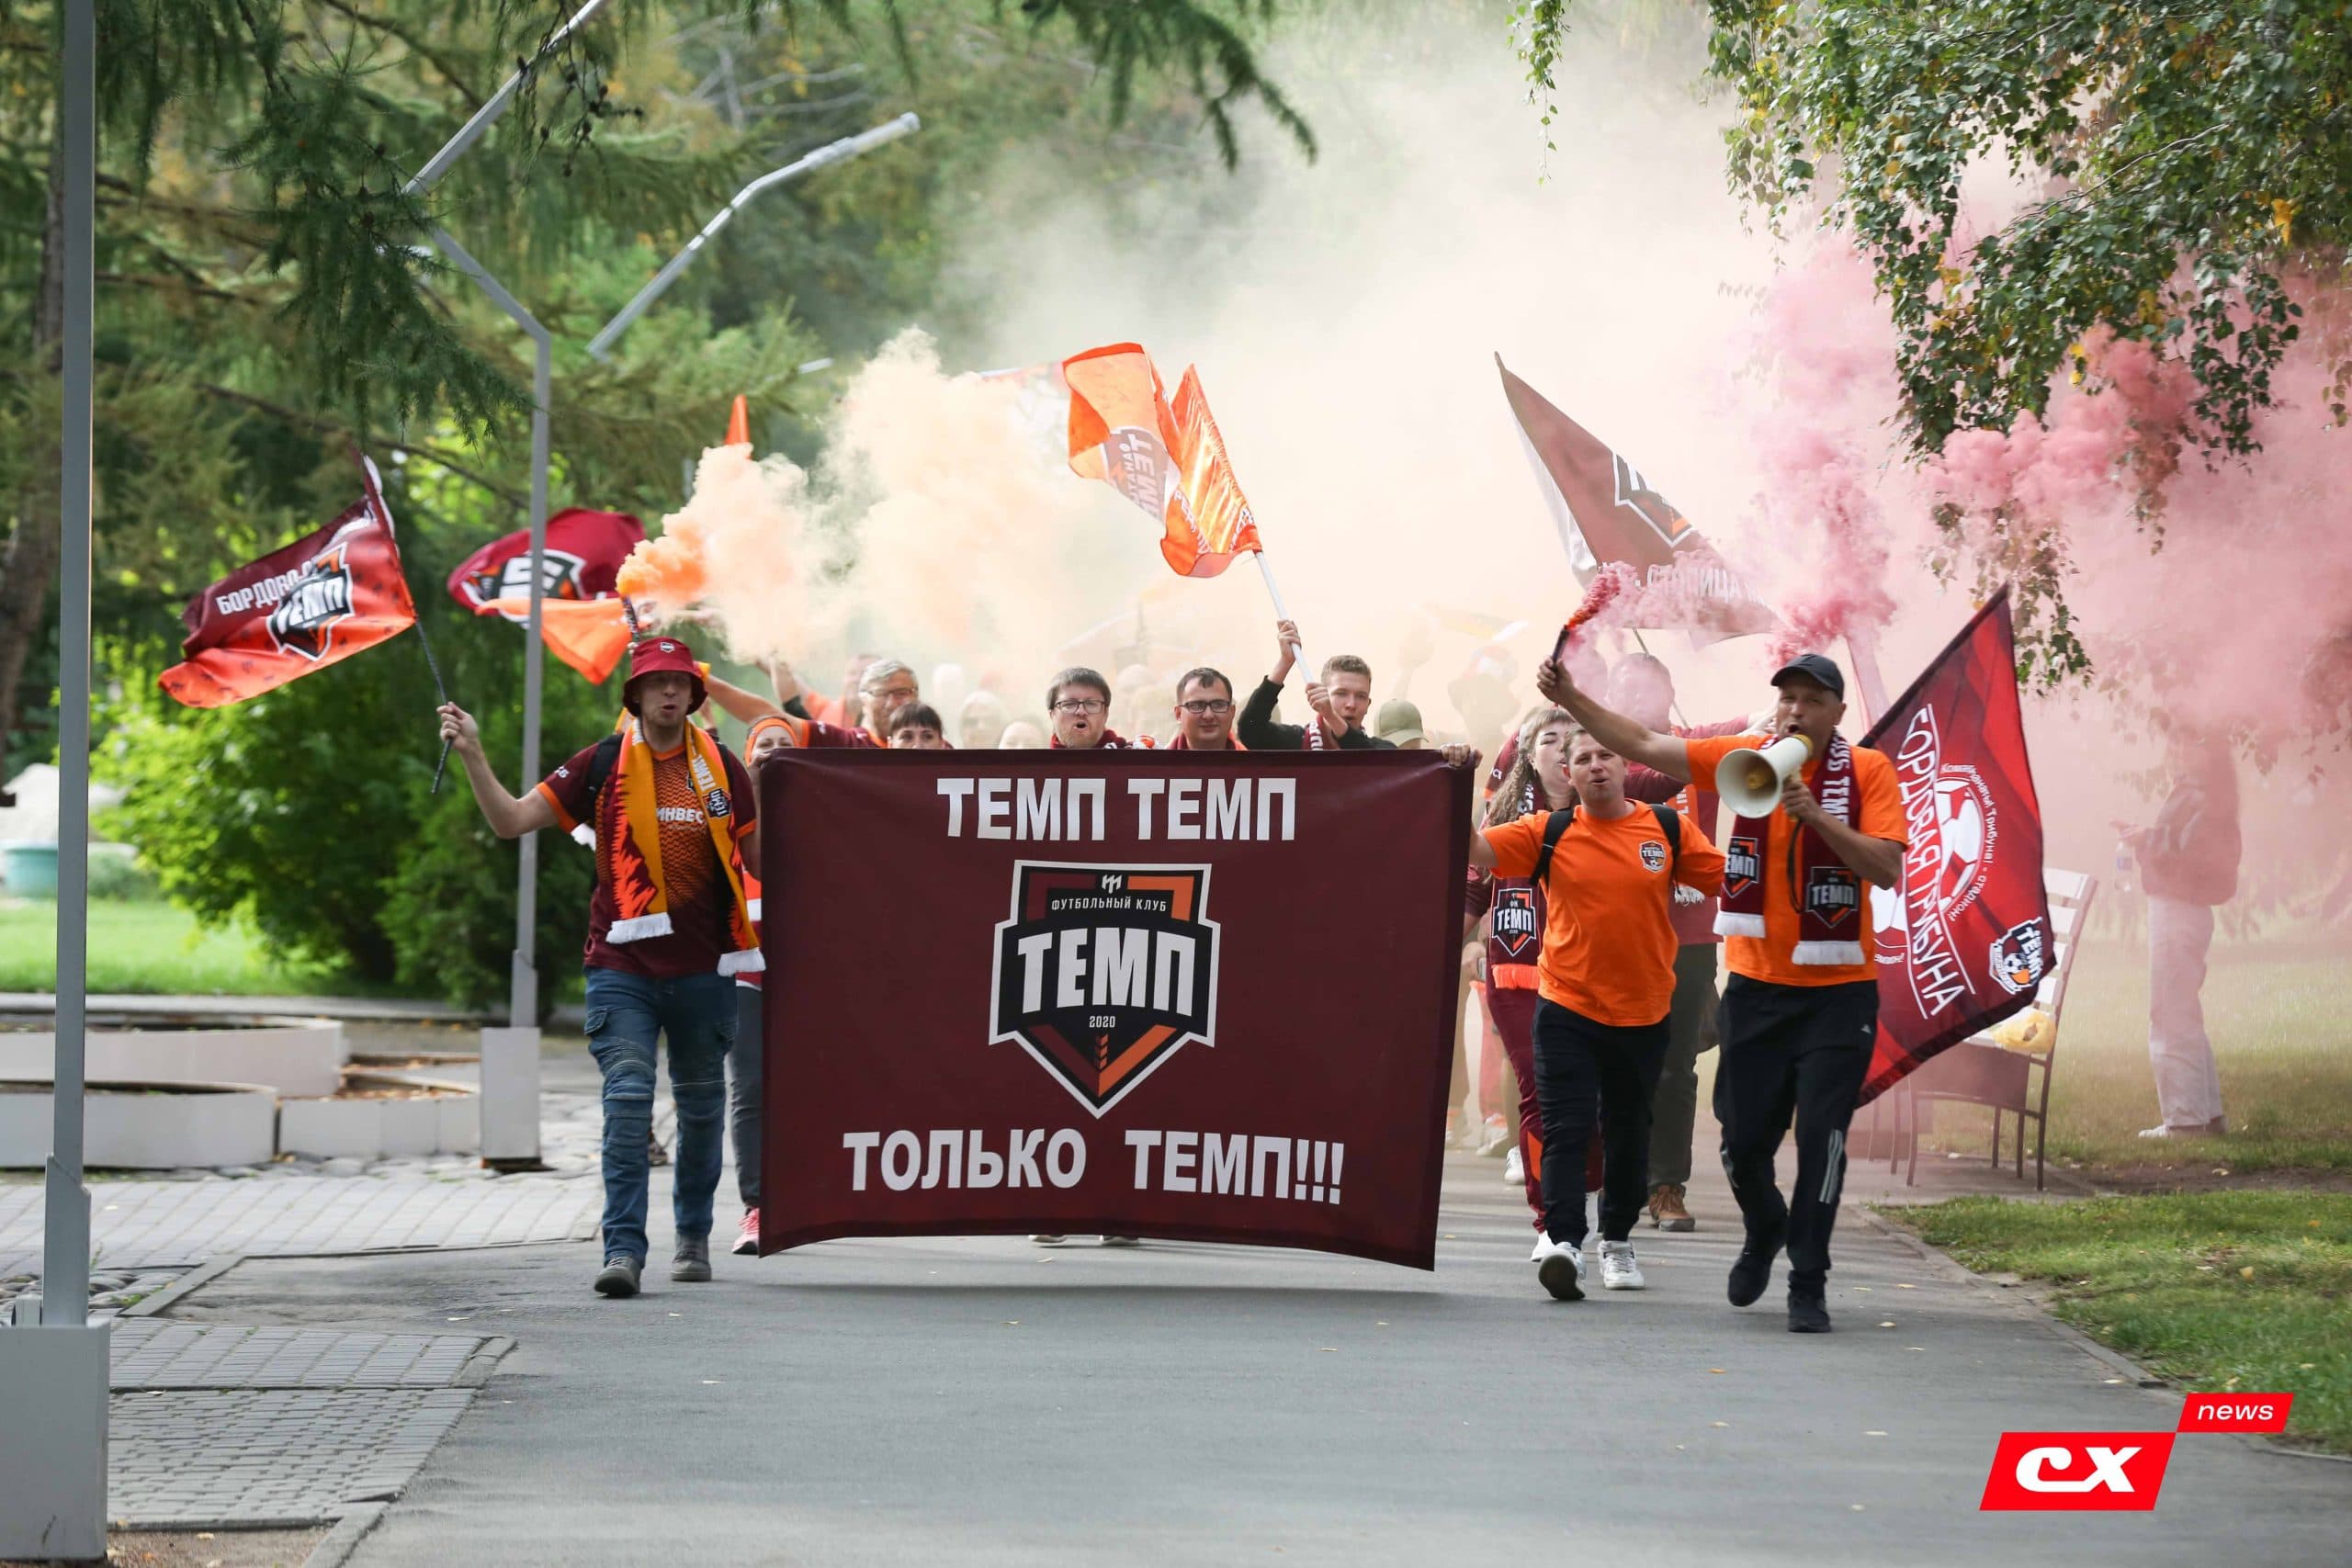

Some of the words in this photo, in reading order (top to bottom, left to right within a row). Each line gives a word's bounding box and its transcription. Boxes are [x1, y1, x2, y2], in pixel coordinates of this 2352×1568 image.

[937, 778, 1105, 841] ТЕМП
[1127, 778, 1296, 841] ТЕМП
[1821, 776, 1850, 826] ТЕМ
[1725, 854, 1755, 877] ЕМП
[1051, 896, 1131, 910] ФУТБОЛЬНЫЙ
[1136, 898, 1167, 911] КЛУБ
[1812, 884, 1854, 905] ТЕМП
[1948, 874, 1987, 922] стадион!
[1498, 908, 1532, 932] ТЕМП
[1908, 868, 1965, 1016] ТРИБУНА
[1018, 927, 1196, 1017] ТЕМП
[1089, 1015, 1116, 1028] 2020
[842, 1128, 1087, 1192] ТОЛЬКО
[1125, 1129, 1344, 1205] ТЕМП!!!
